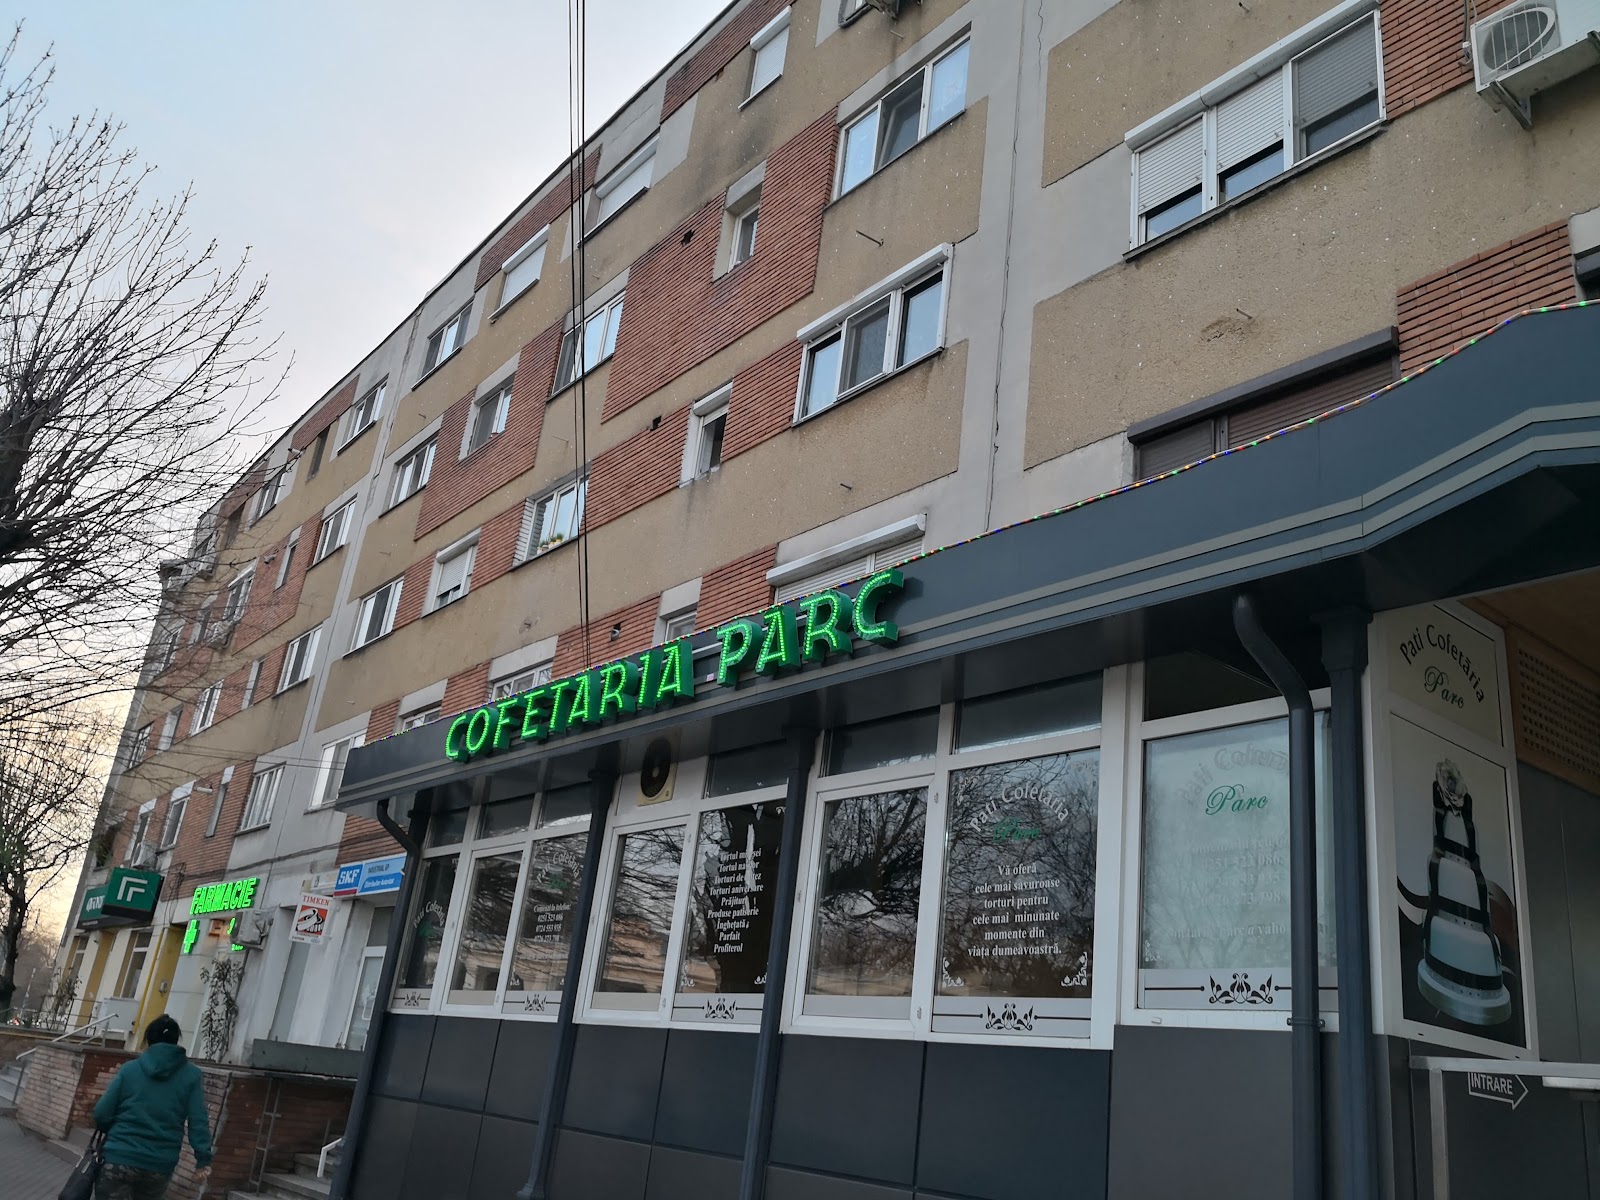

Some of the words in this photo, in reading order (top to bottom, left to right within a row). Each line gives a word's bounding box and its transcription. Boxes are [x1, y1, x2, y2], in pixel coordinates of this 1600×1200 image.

[1400, 627, 1424, 666] Pati
[444, 641, 694, 763] COFETARIA
[716, 567, 904, 688] PARC
[1424, 666, 1464, 709] Parc
[1205, 783, 1269, 816] Parc
[969, 796, 998, 832] Pati
[719, 862, 739, 873] Tortul
[998, 865, 1011, 876] Vă
[1013, 863, 1037, 875] oferă
[338, 869, 360, 885] SKF
[714, 873, 736, 885] Torturi
[709, 883, 731, 896] Torturi
[975, 883, 992, 894] cele
[994, 881, 1012, 892] mai
[1013, 878, 1061, 891] savuroase
[189, 877, 260, 915] FARMACIE
[303, 895, 330, 906] TIMKEN
[984, 896, 1014, 909] torturi
[1016, 896, 1049, 911] pentru
[707, 908, 732, 919] Produse
[732, 907, 760, 919] patiserie
[972, 914, 990, 925] cele
[992, 912, 1009, 924] mai
[1014, 911, 1060, 923] minunate
[719, 930, 741, 941] Parfait
[984, 929, 1027, 941] momente
[1029, 927, 1045, 939] din
[713, 942, 744, 954] Profiterol
[1471, 1072, 1514, 1096] INTRARE
